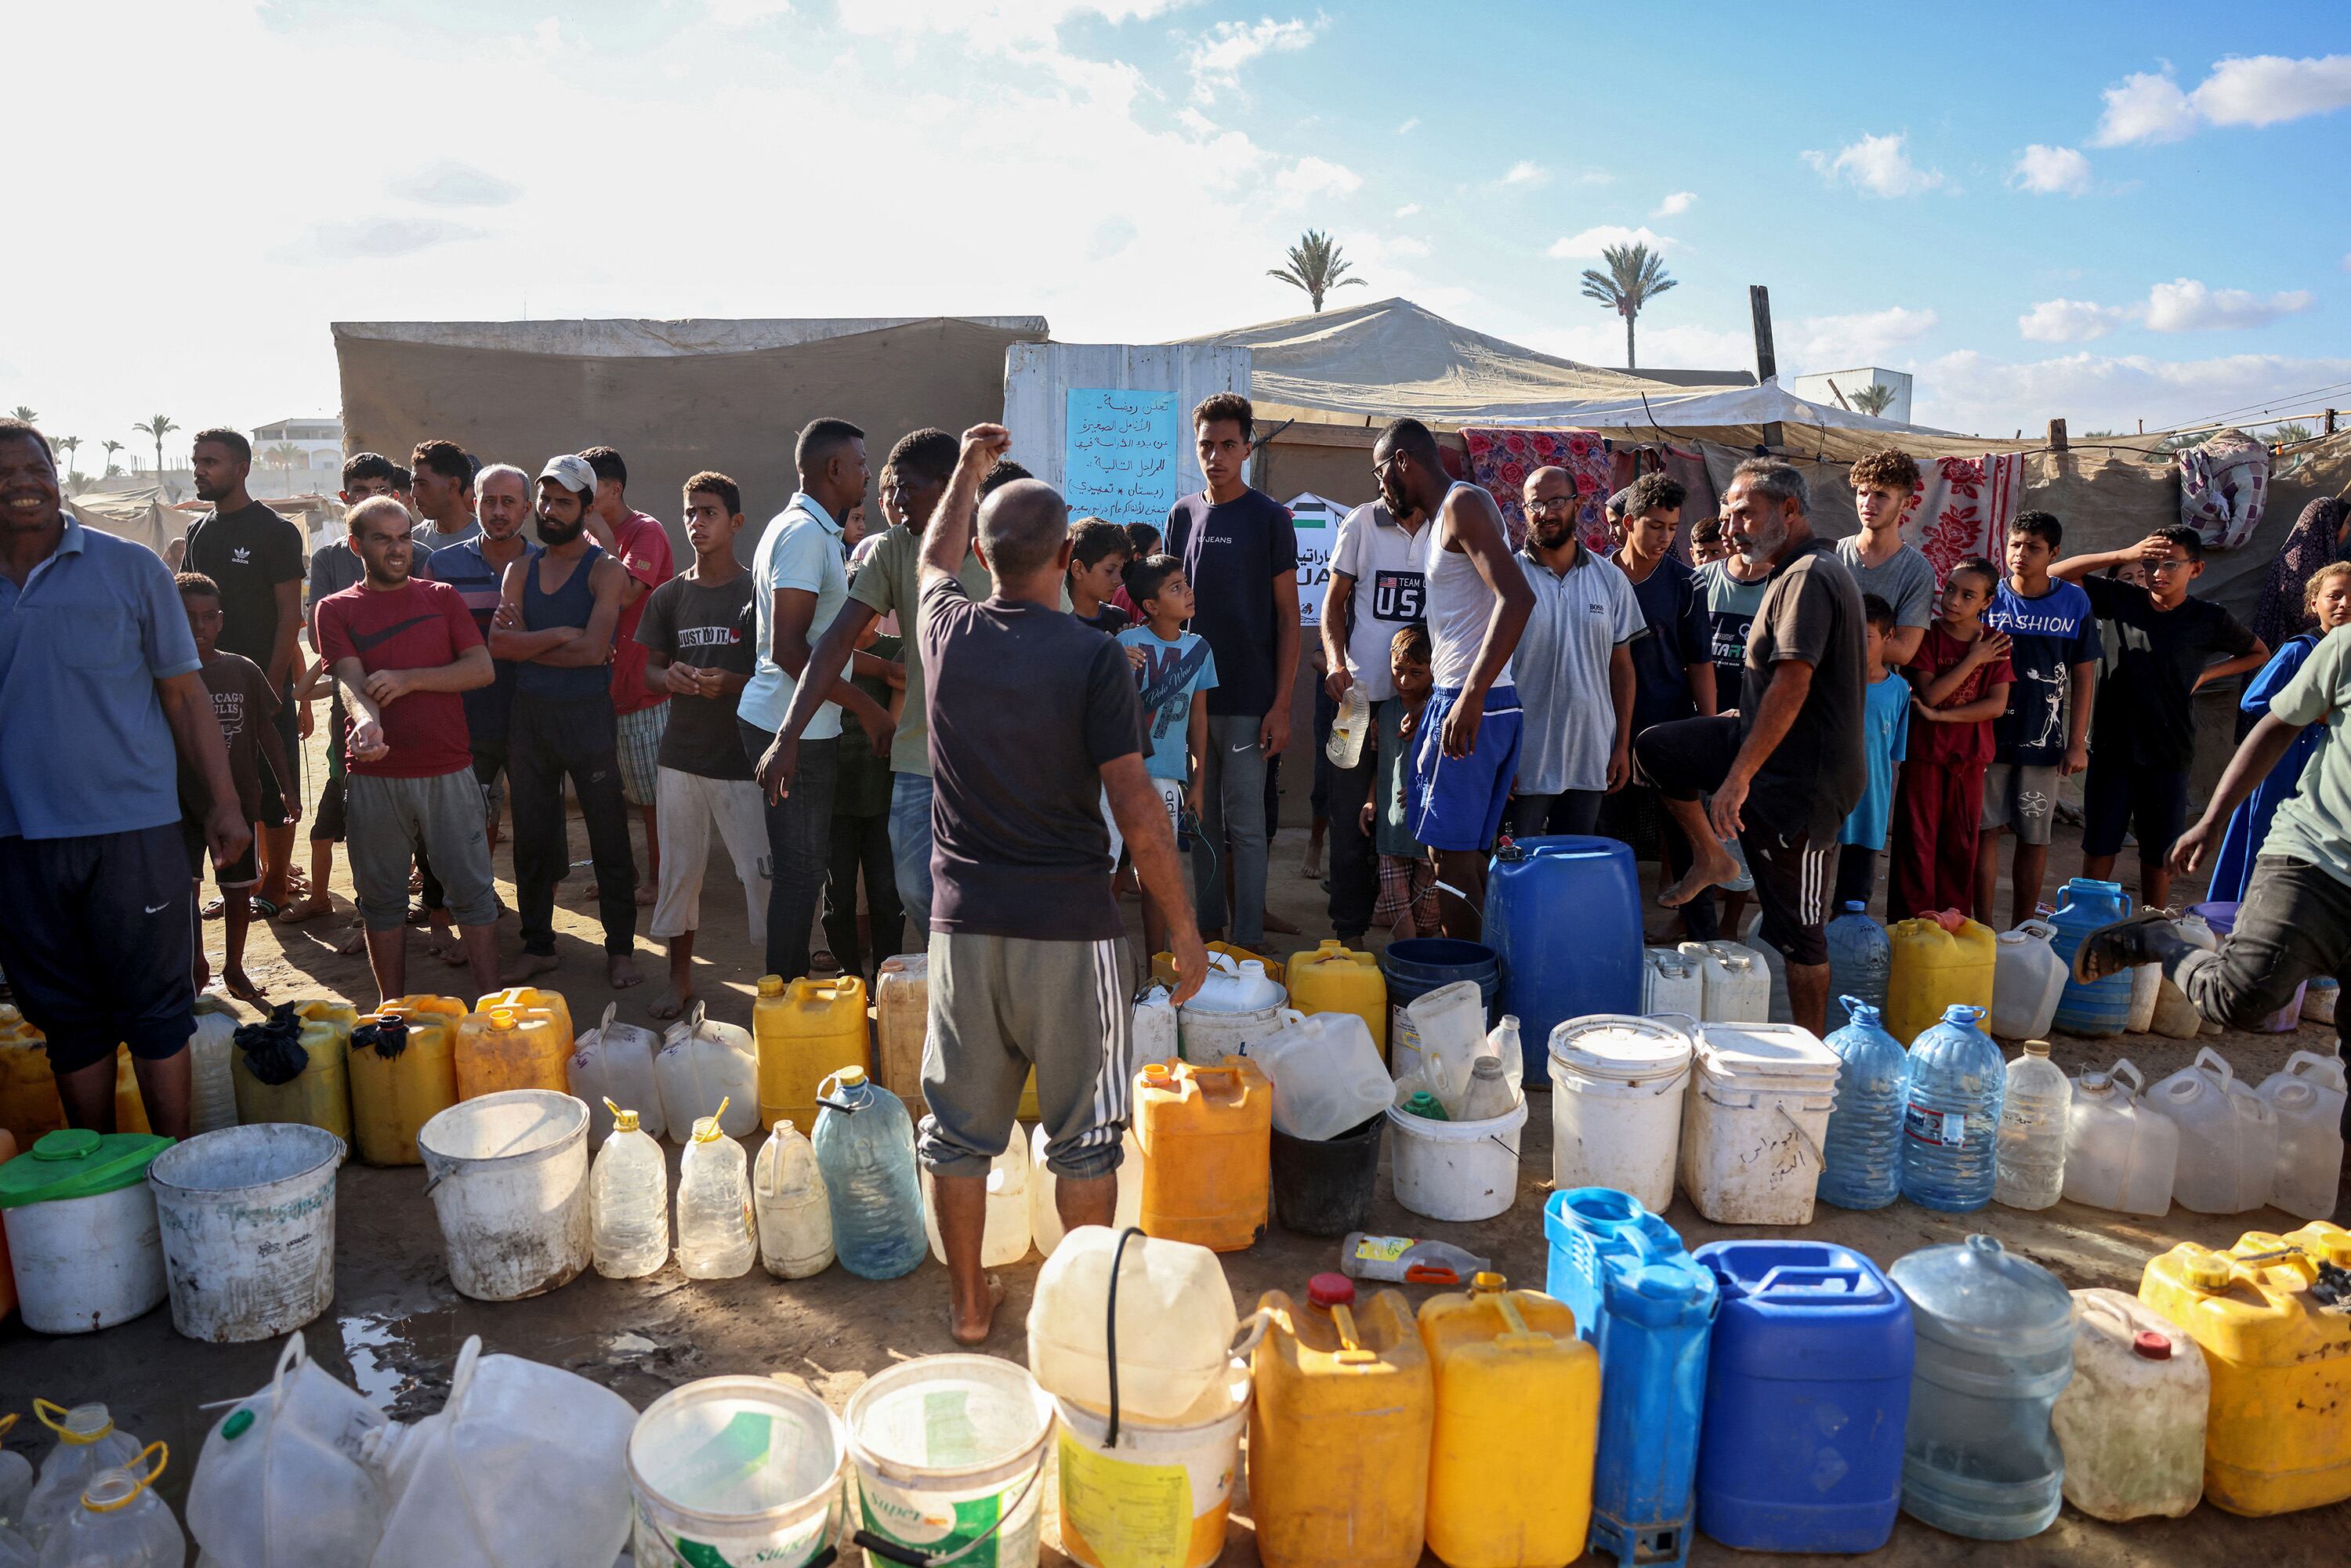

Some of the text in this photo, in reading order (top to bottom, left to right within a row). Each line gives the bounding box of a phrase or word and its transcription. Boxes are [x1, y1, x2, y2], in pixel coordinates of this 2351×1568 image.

[1142, 400, 1169, 415] تعلن
[1076, 418, 1117, 434] الصغيرة
[1153, 440, 1168, 449] عن
[1110, 500, 1121, 517] عام
[1296, 548, 1330, 566] اراتي
[1399, 578, 1420, 588] TEAM
[1987, 613, 2075, 633] FASHION
[1712, 643, 1748, 659] TART
[1145, 664, 1193, 706] Polo Wear
